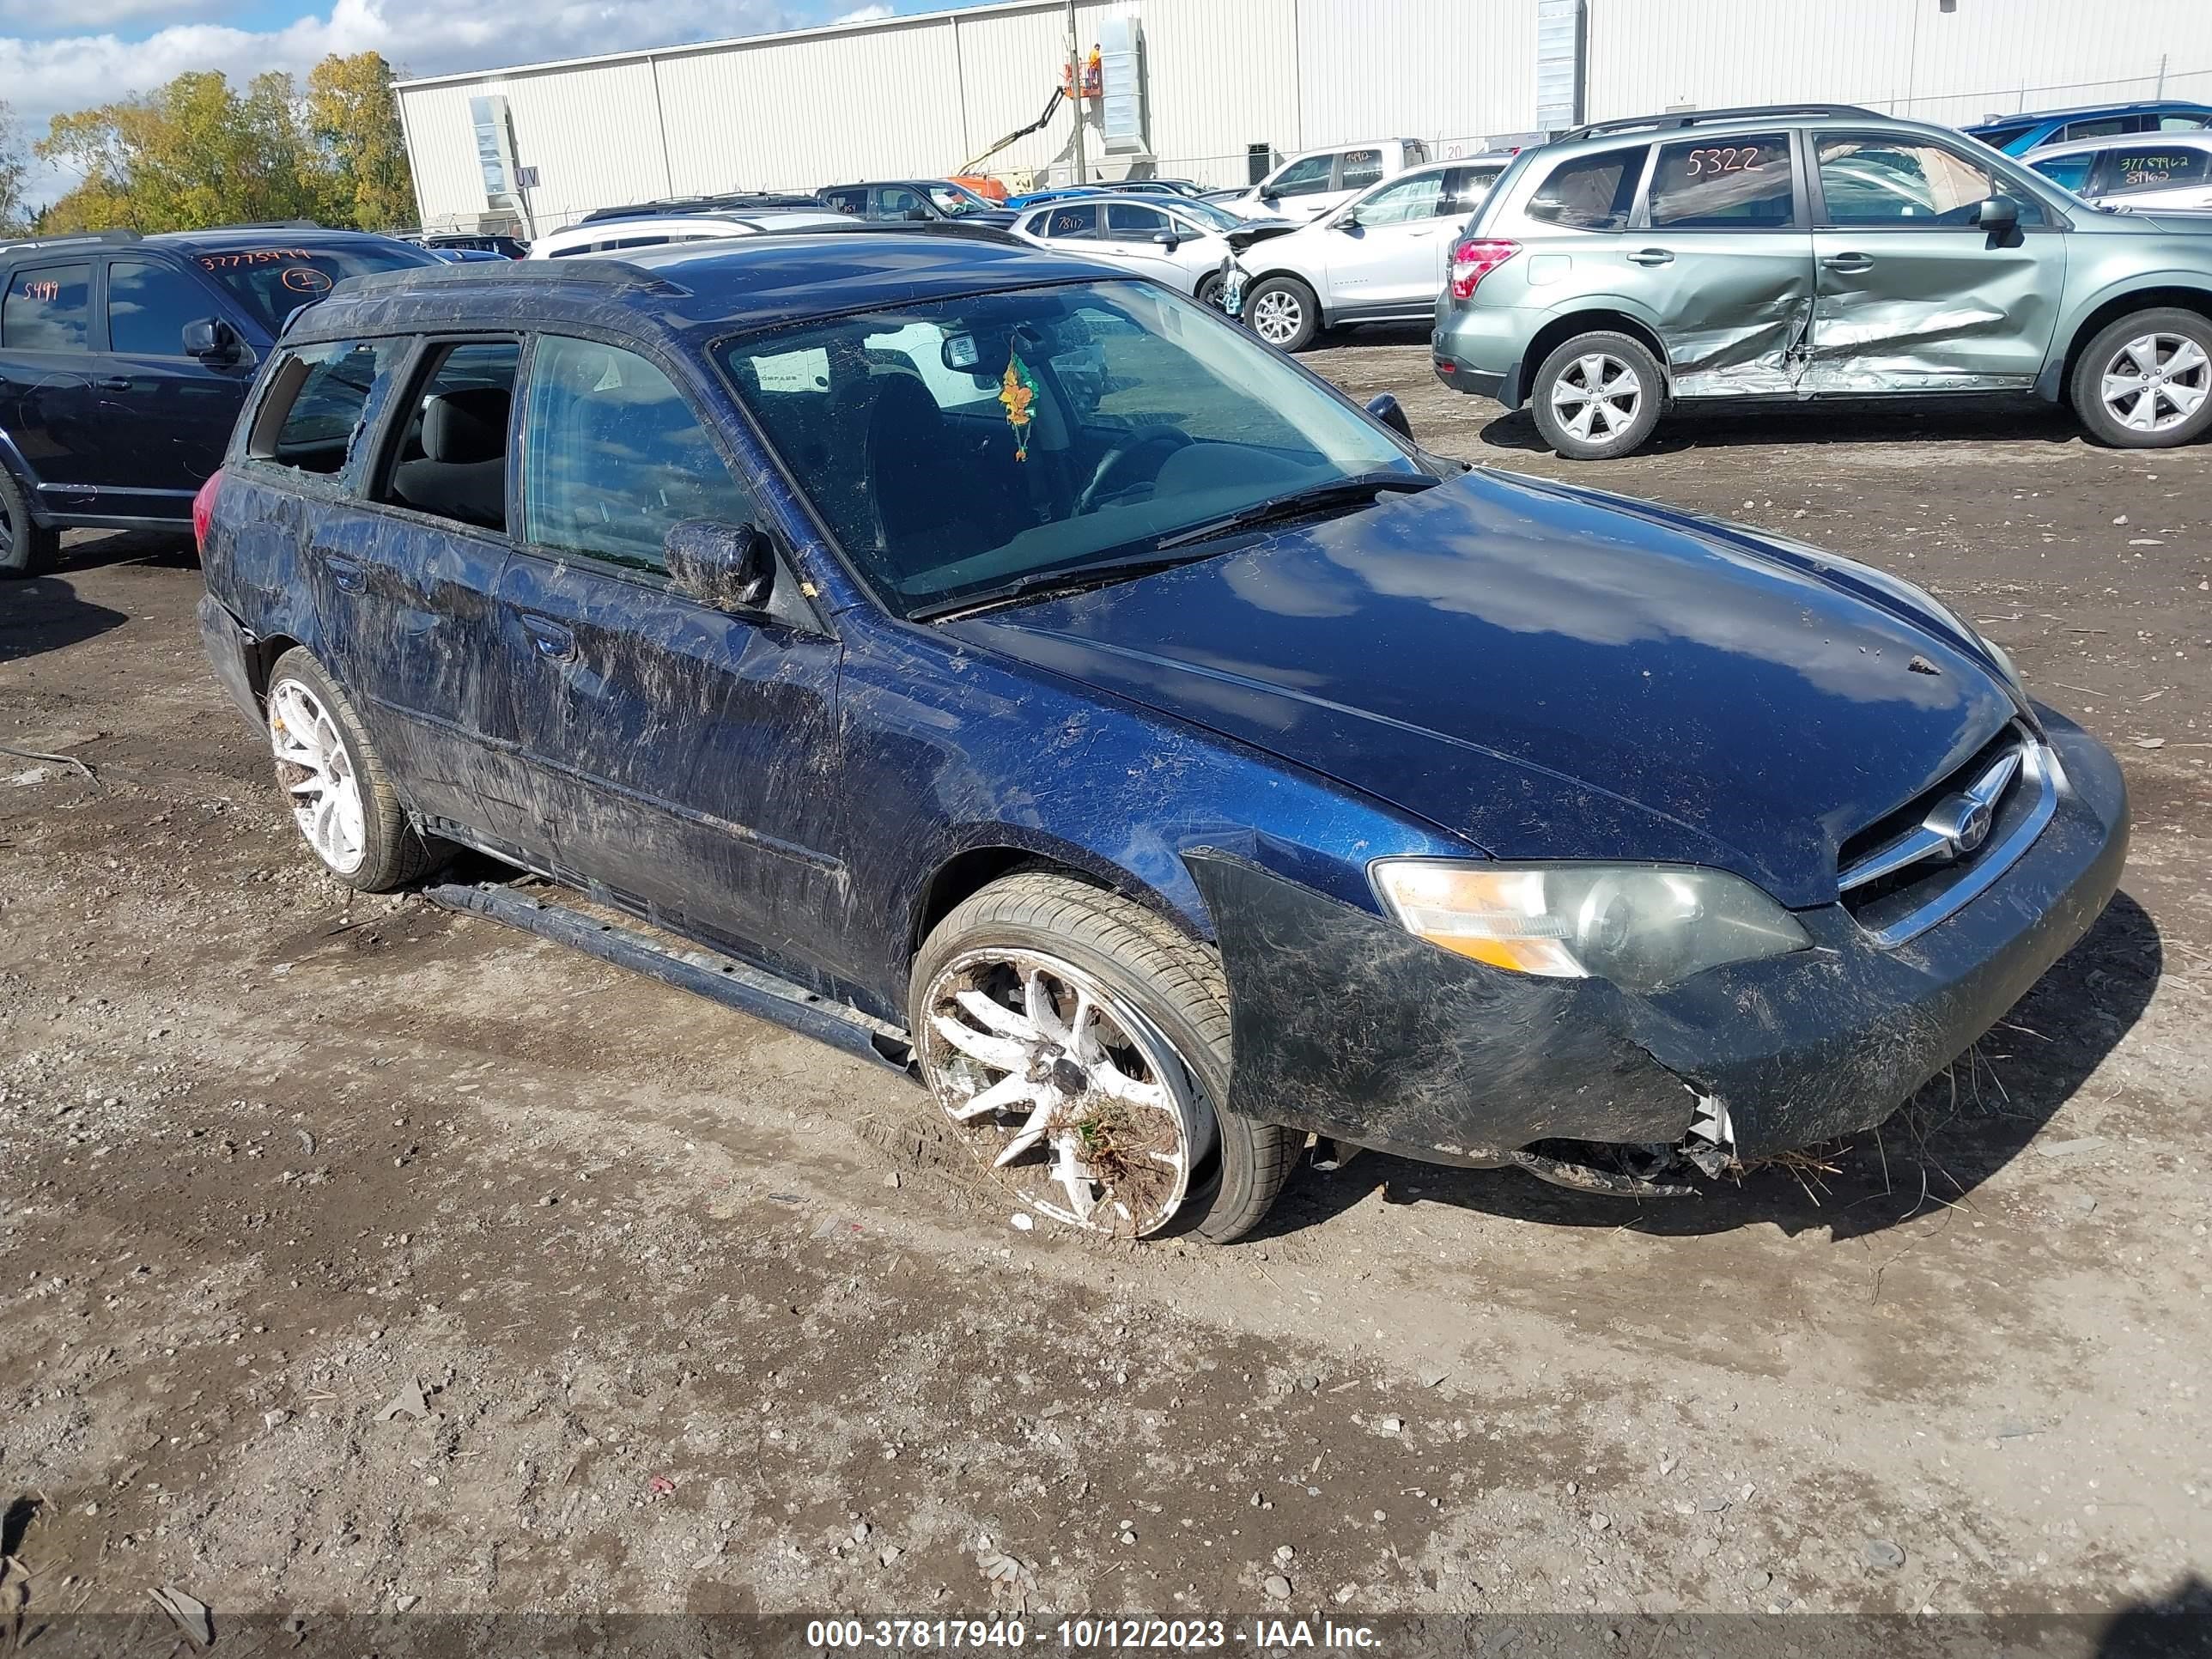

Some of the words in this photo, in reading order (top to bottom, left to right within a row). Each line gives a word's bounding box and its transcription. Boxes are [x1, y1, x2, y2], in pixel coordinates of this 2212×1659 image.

[1448, 145, 1462, 159] 20
[1686, 147, 1764, 176] 5322
[1058, 216, 1084, 230] 78117
